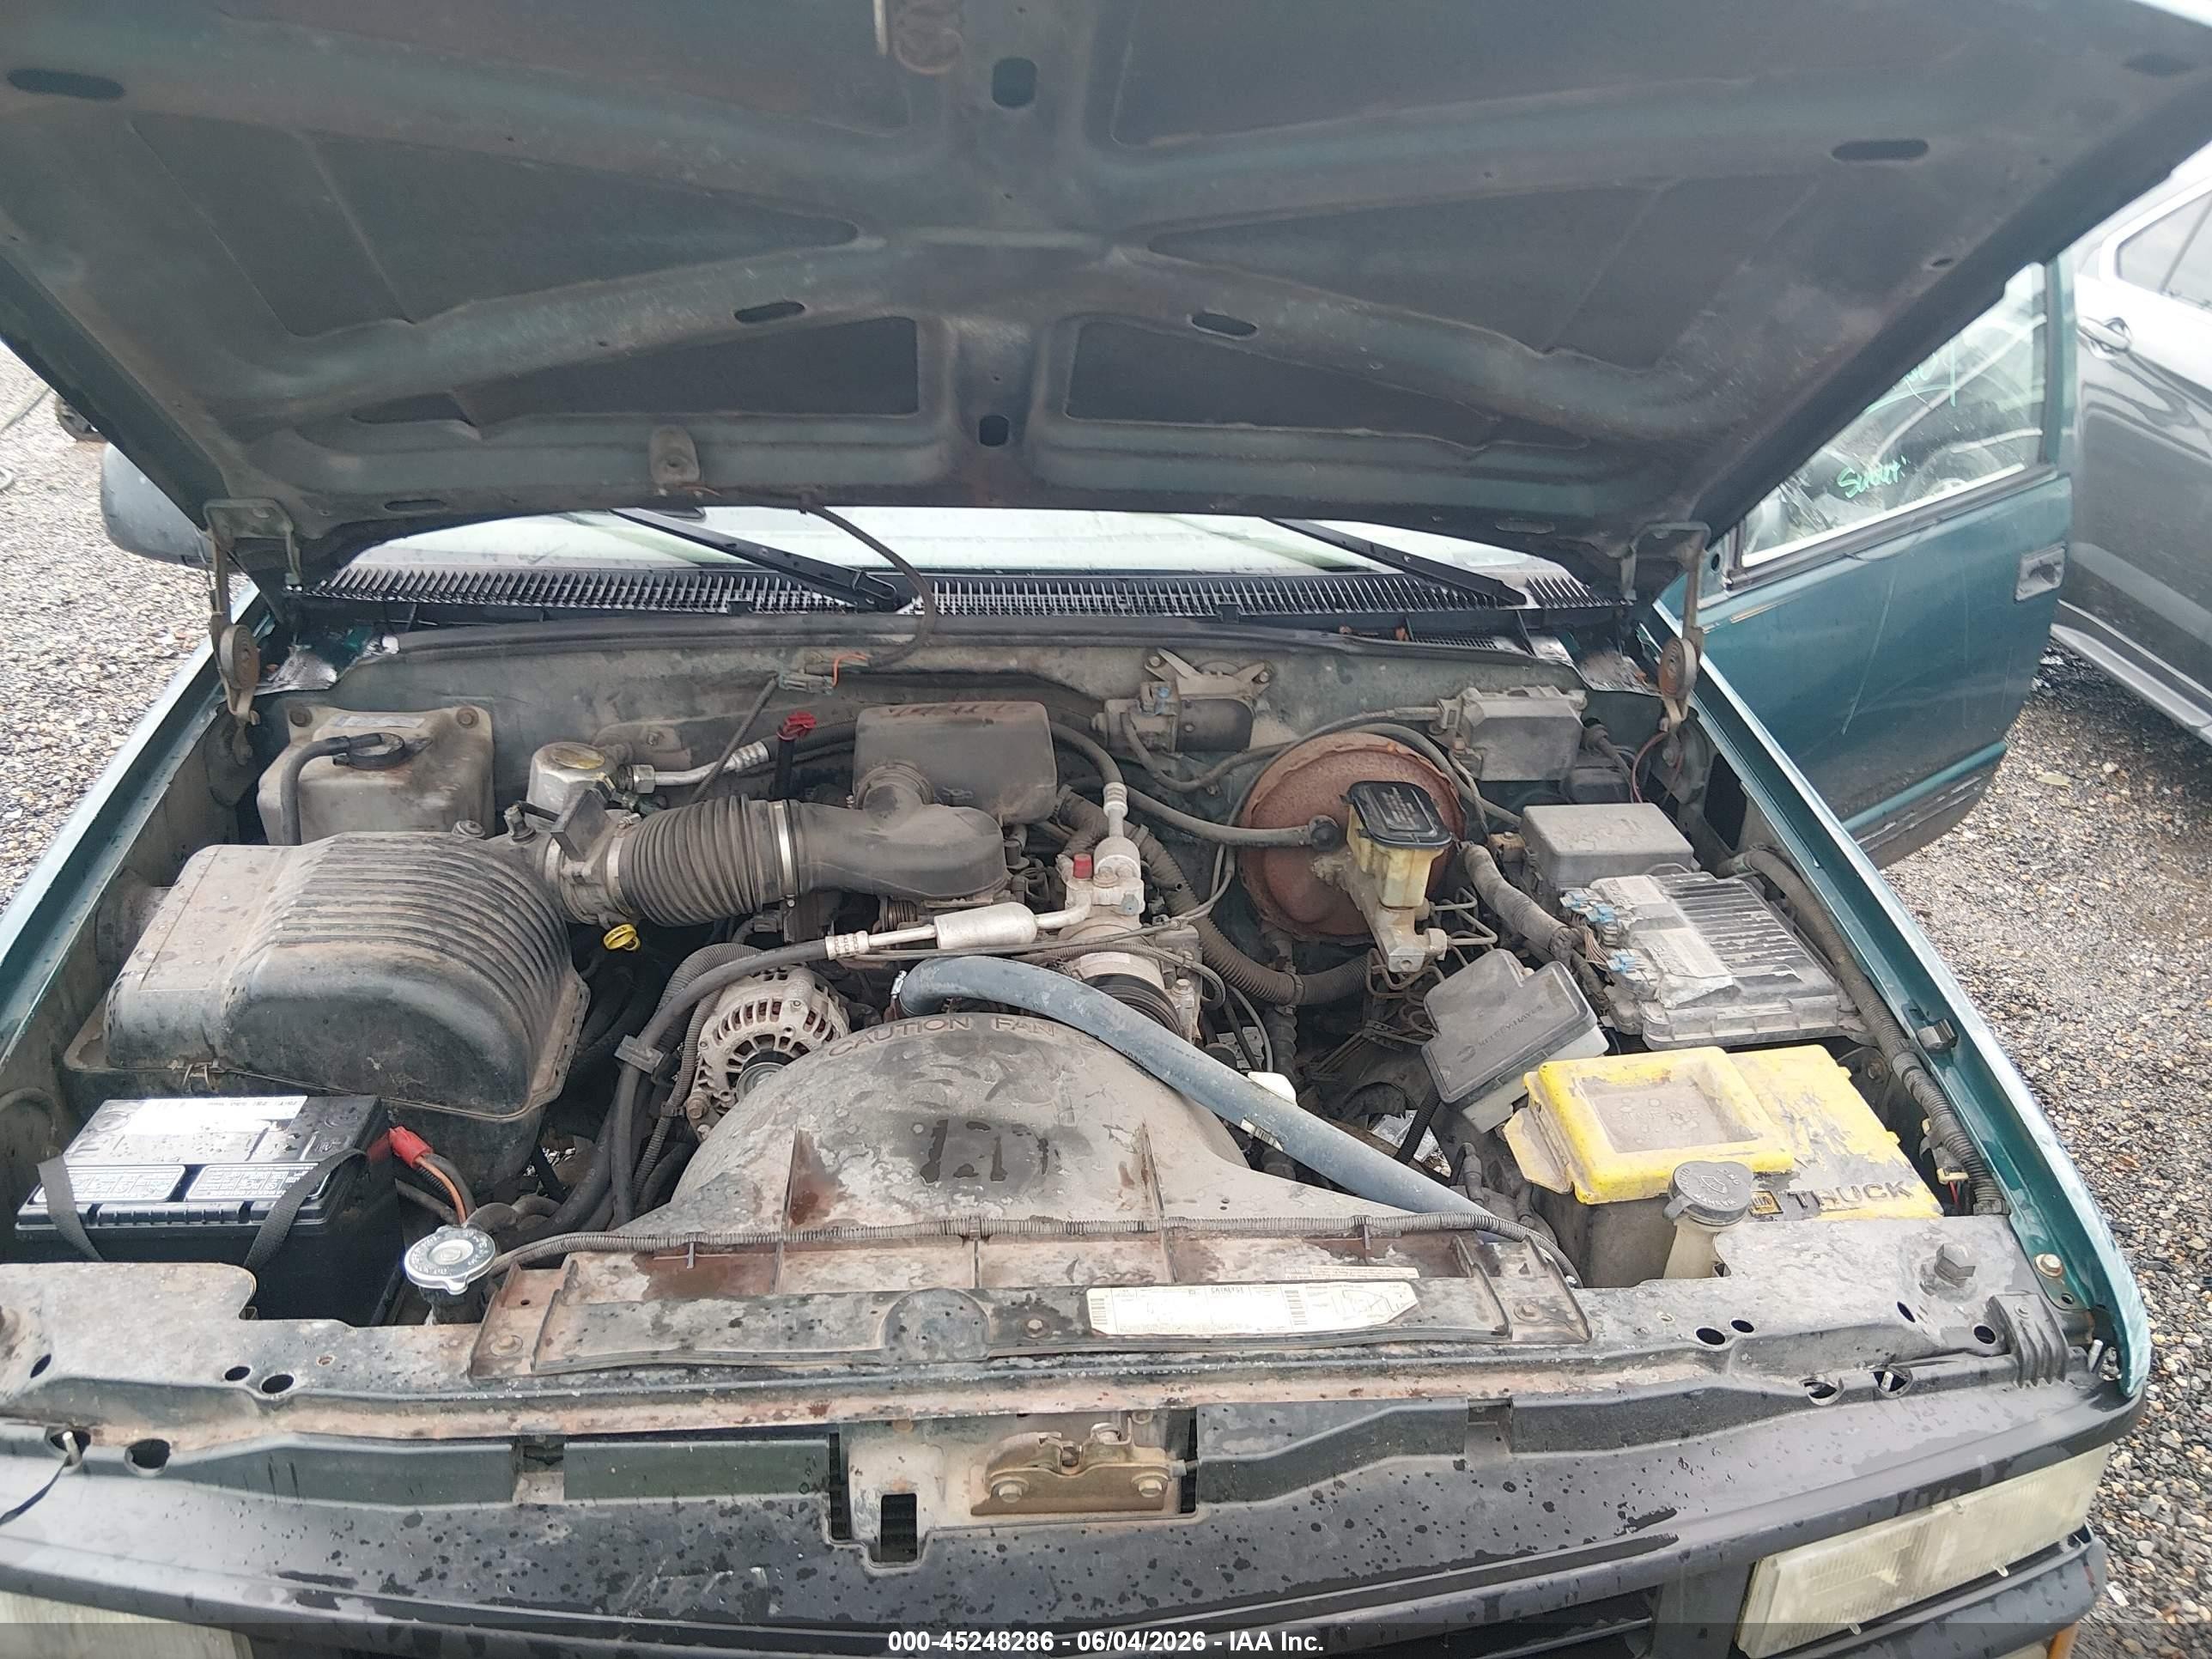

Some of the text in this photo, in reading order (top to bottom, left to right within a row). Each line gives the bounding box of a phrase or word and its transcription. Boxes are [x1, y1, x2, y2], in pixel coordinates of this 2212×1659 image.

[828, 1017, 1057, 1057] CAUTION FAN
[1786, 1181, 1914, 1209] TRUCK
